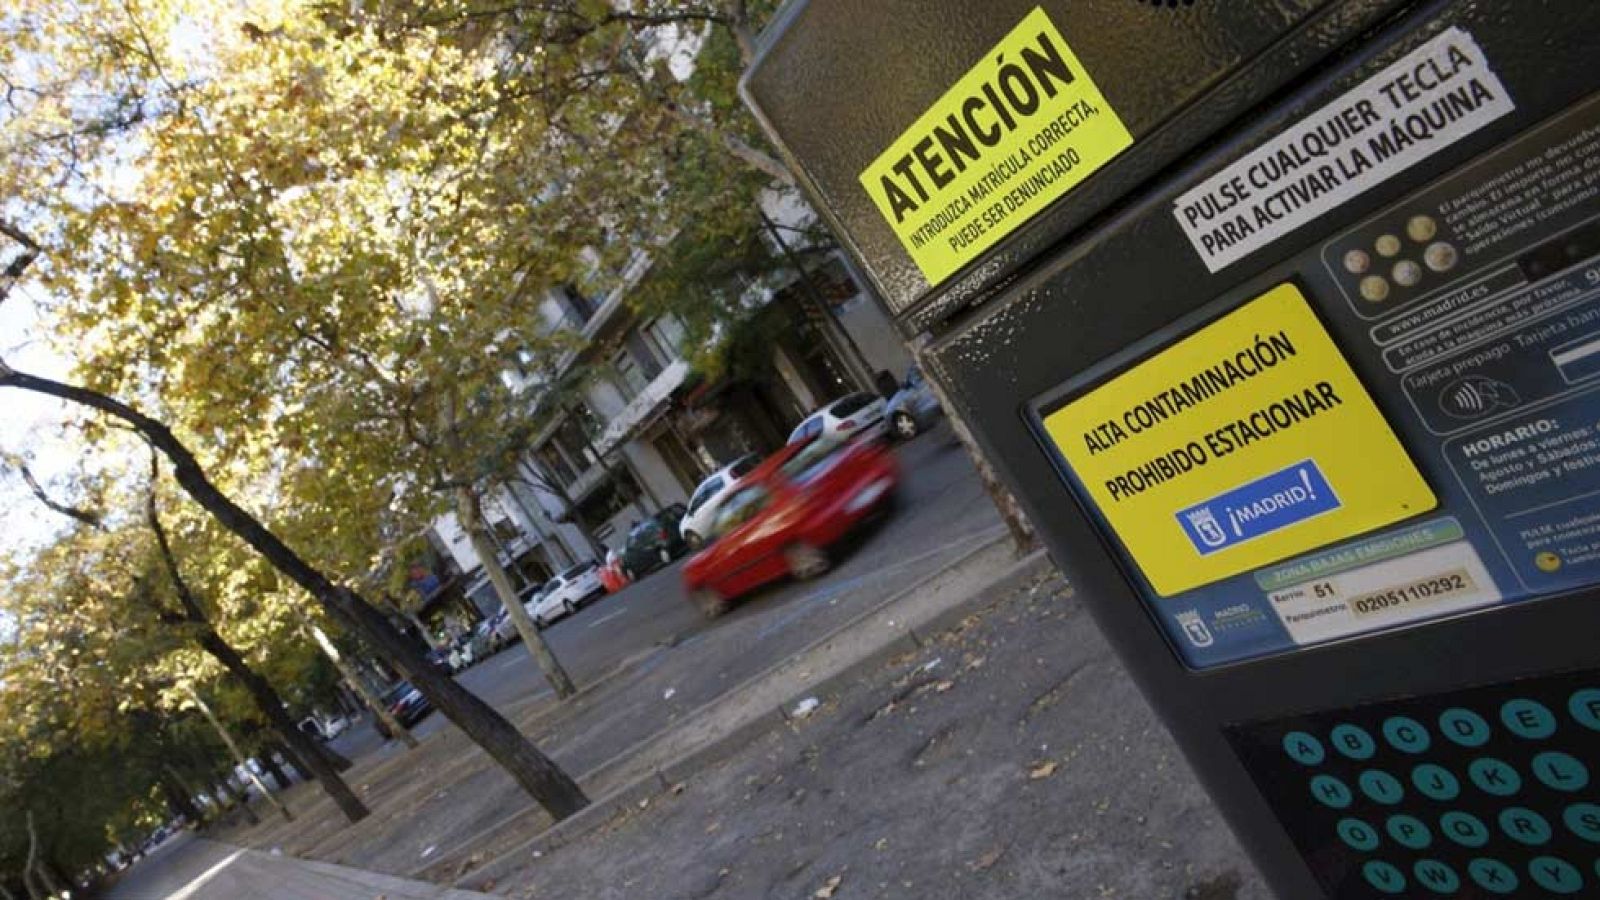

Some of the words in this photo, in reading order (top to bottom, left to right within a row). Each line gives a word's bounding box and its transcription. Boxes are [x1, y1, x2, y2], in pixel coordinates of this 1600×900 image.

[880, 31, 1076, 224] ATENCIÓN
[1183, 176, 1252, 228] PULSE
[1249, 99, 1381, 191] CUALQUIER
[1379, 44, 1473, 110] TECLA
[909, 195, 973, 249] INTRODUZCA
[969, 148, 1033, 203] MATRÍCULA
[1027, 99, 1099, 157] CORRECTA,
[1200, 214, 1255, 256] PARA
[1254, 166, 1342, 230] ACTIVAR
[1340, 146, 1374, 181] LA
[1369, 77, 1495, 164] MÁQUINA
[950, 221, 985, 252] PUEDE
[982, 206, 1006, 229] SER
[1003, 147, 1081, 213] DENUNCIADO
[1390, 284, 1490, 334] www.madrid.es
[1512, 322, 1567, 348] Tarjeta
[1407, 366, 1451, 389] Tarjeta
[1452, 342, 1511, 375] prepago
[1083, 420, 1129, 456] ALTA
[1122, 330, 1297, 434] CONTAMINACIÓN
[1104, 441, 1208, 502] PROHIBIDO
[1204, 381, 1343, 459] ESTACIONAR
[1462, 419, 1560, 458] HORARIO:
[1313, 582, 1336, 599] 51
[1356, 574, 1466, 614] 0205110292
[1297, 742, 1315, 756] A
[1344, 734, 1362, 750] B
[1397, 726, 1418, 743] C
[1453, 718, 1474, 736] D
[1515, 709, 1540, 728] E
[1321, 783, 1341, 800] H
[1374, 779, 1387, 795] I
[1430, 774, 1446, 790] J
[1482, 767, 1506, 785] K
[1549, 762, 1572, 781] L
[1349, 826, 1366, 842] O
[1399, 823, 1416, 840] P
[1453, 820, 1476, 837] Q
[1513, 815, 1538, 835] R
[1580, 812, 1600, 831] S
[1375, 867, 1391, 883] V
[1423, 866, 1448, 884] W
[1484, 866, 1505, 883] X
[1542, 866, 1563, 883] Y
